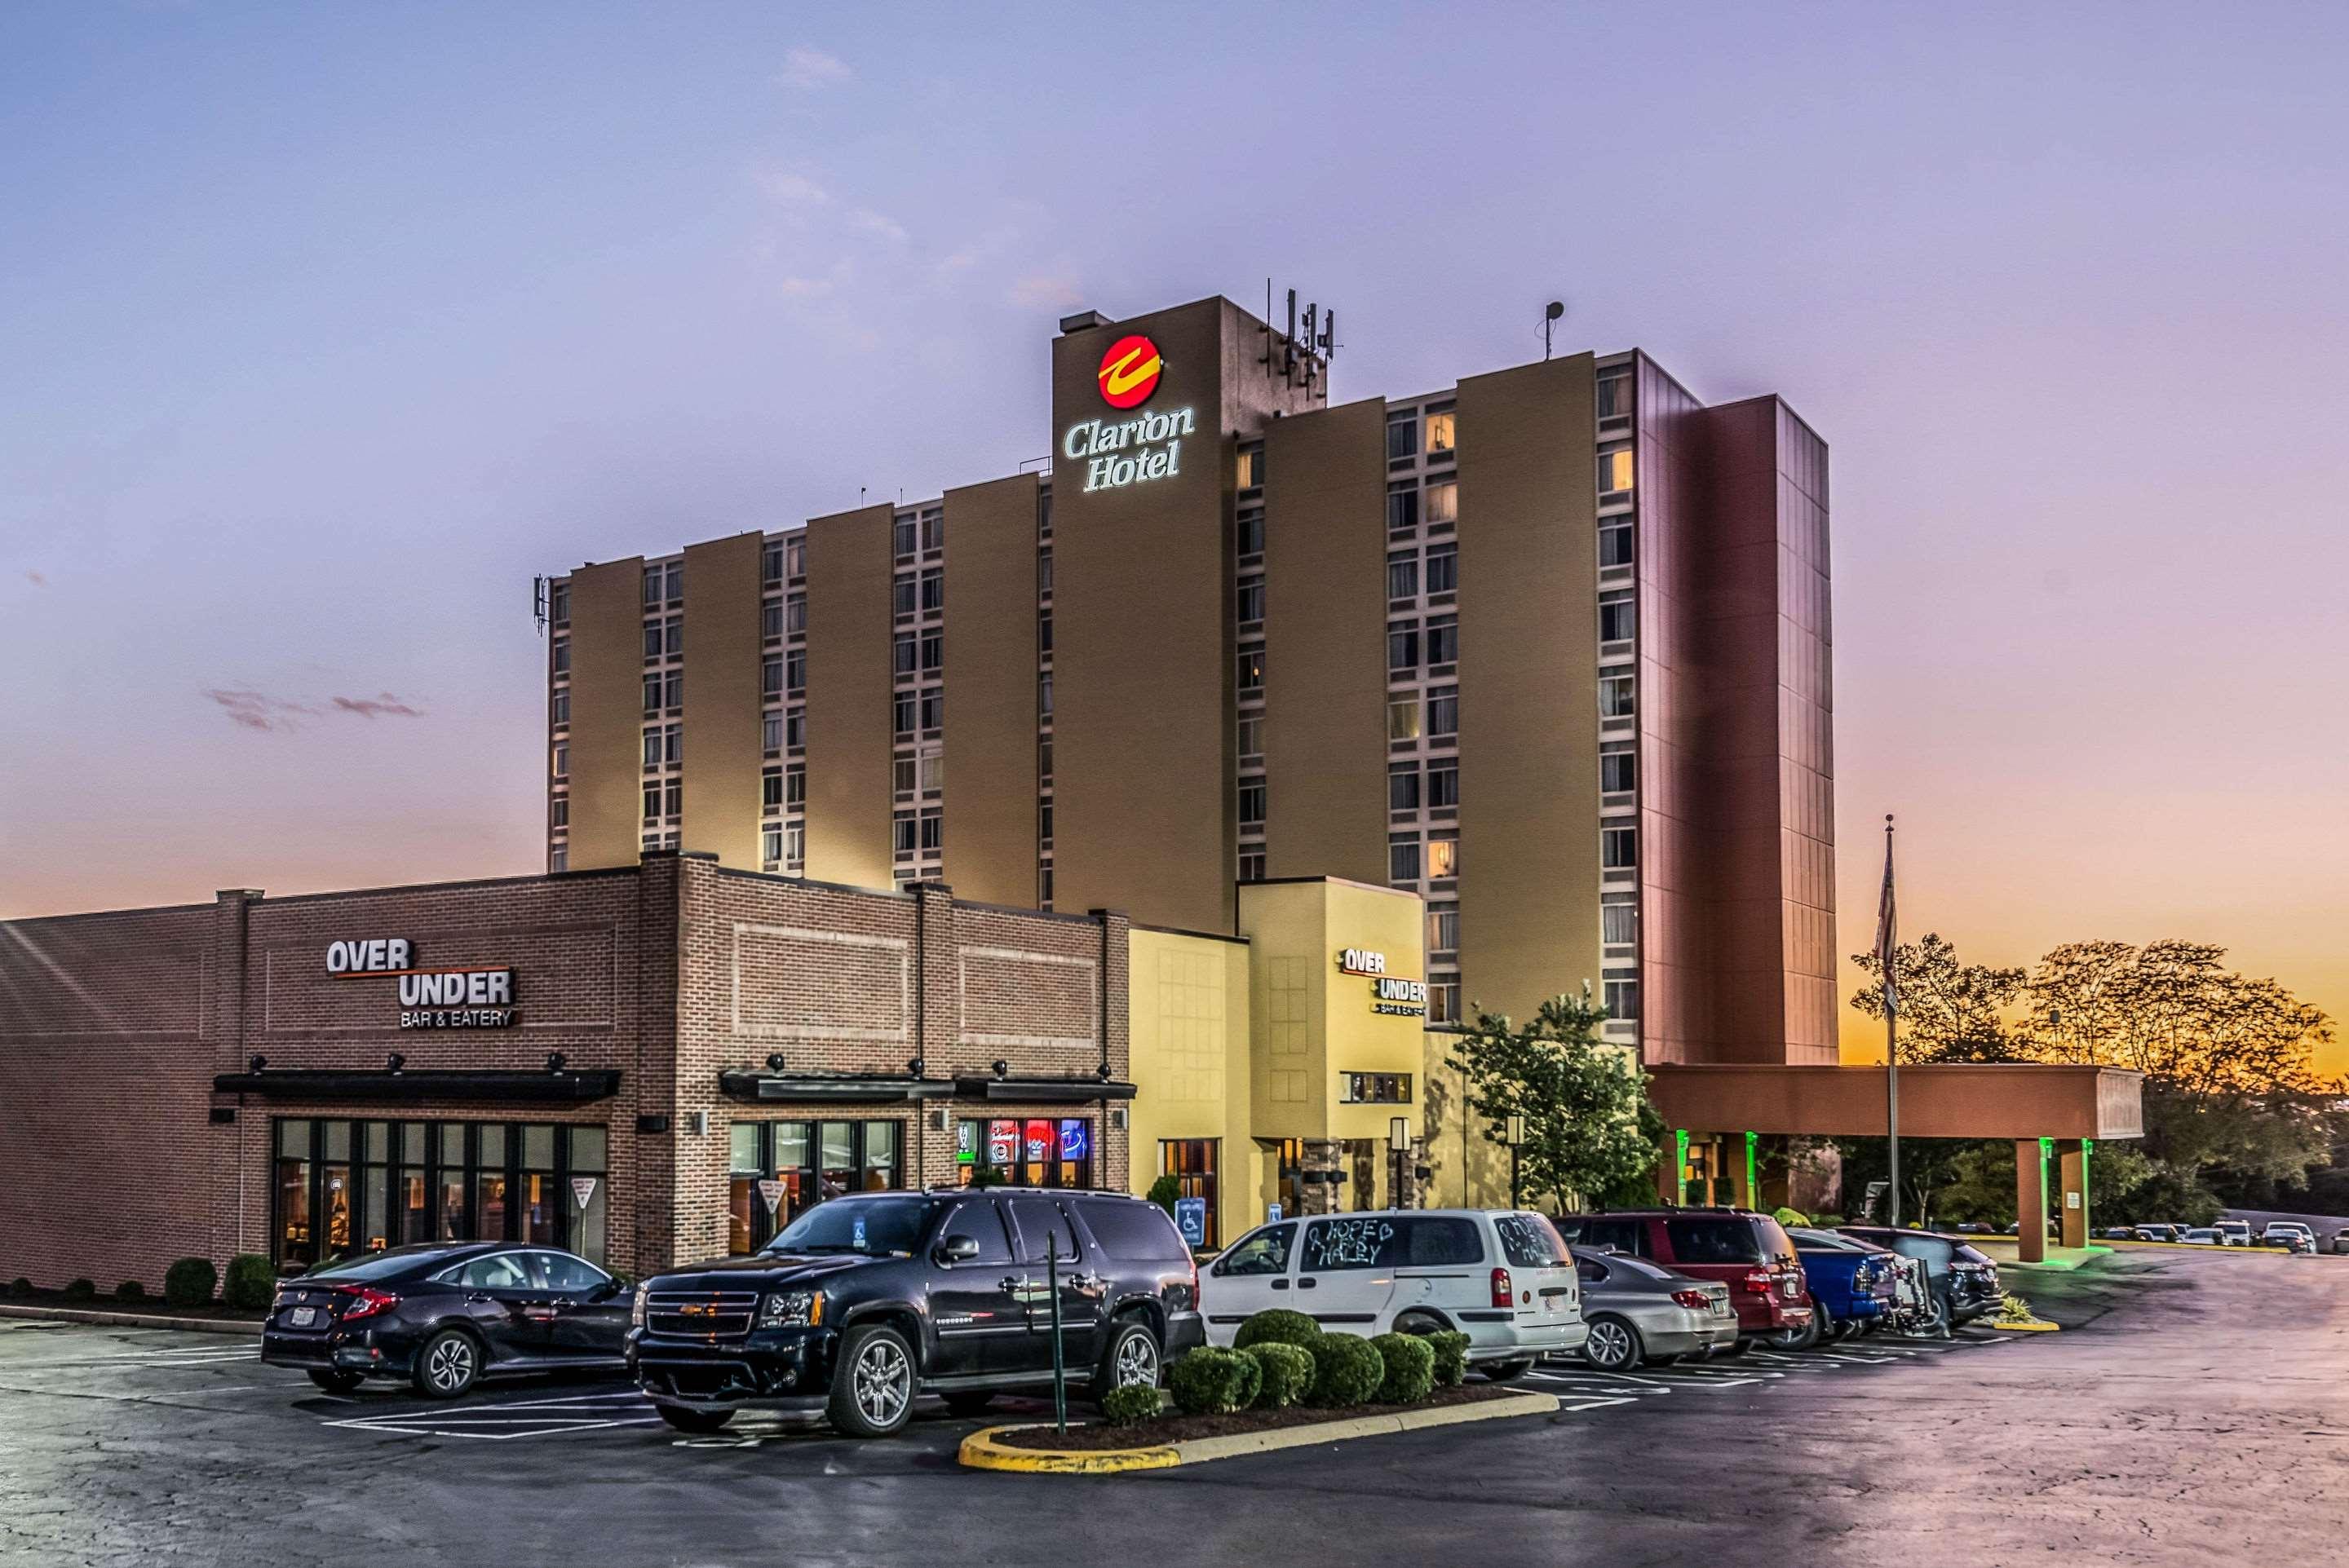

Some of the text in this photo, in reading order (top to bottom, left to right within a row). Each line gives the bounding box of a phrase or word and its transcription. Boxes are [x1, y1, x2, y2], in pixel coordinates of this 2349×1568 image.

[1064, 407, 1195, 459] Clarion
[1083, 440, 1179, 493] Hotel
[327, 939, 409, 972] OVER
[1344, 947, 1385, 973] OVER
[399, 971, 510, 1006] UNDER
[1379, 978, 1427, 1002] UNDER
[400, 1009, 511, 1027] BAR & EATERY
[1326, 1220, 1378, 1240] HOPE
[1318, 1244, 1382, 1266] HALEY
